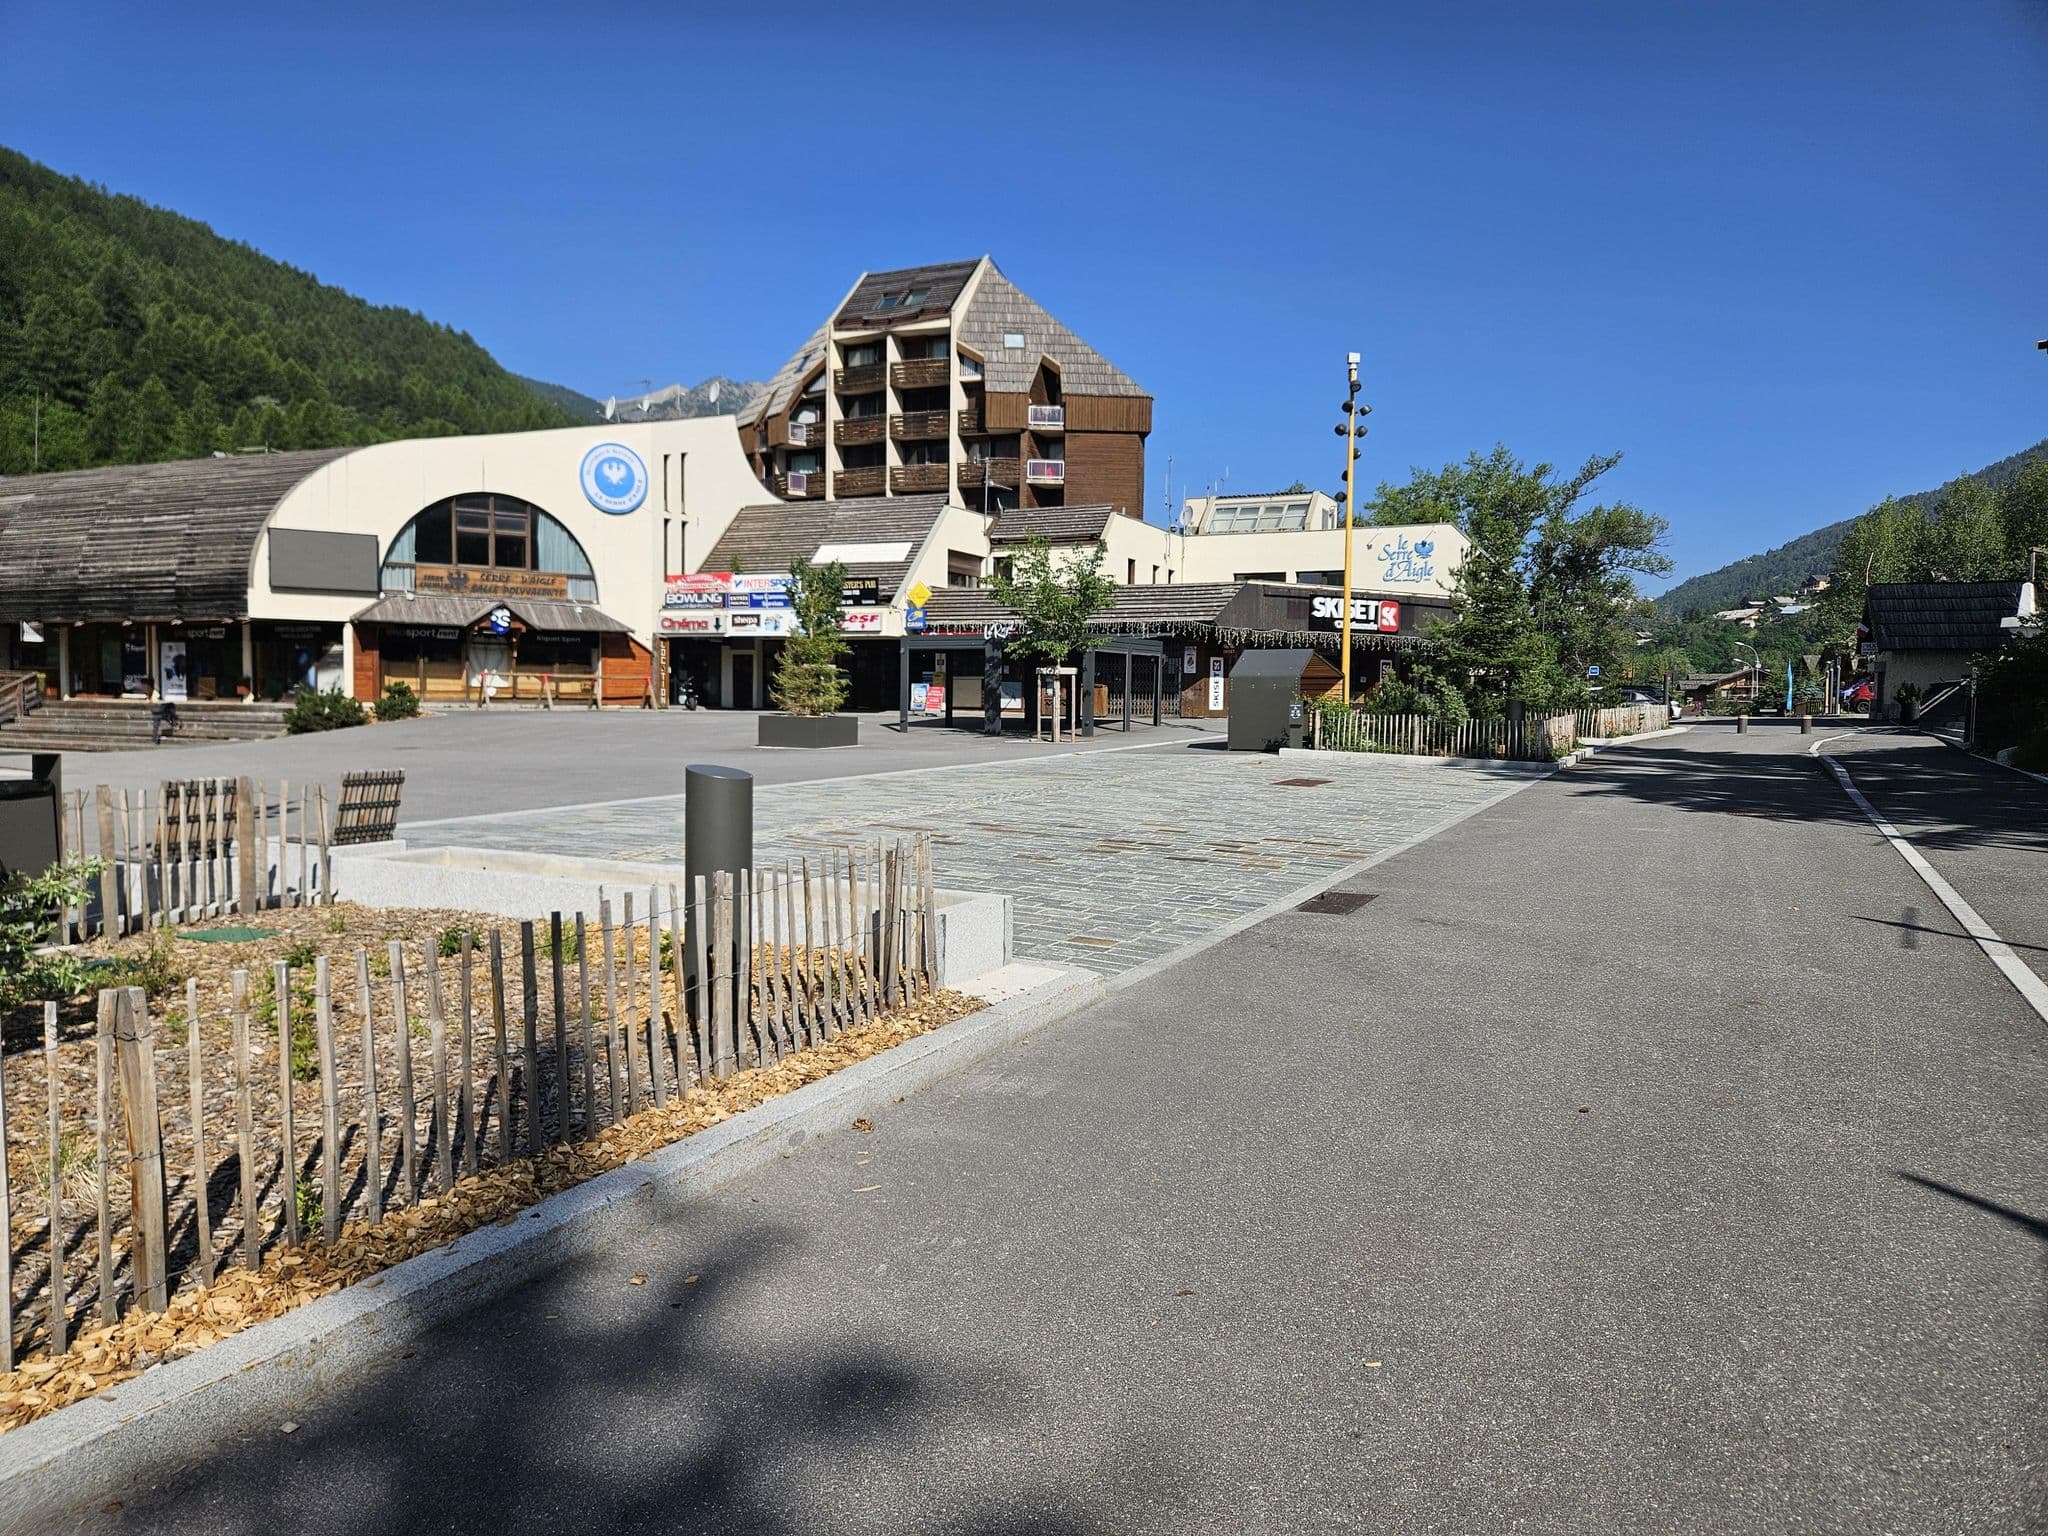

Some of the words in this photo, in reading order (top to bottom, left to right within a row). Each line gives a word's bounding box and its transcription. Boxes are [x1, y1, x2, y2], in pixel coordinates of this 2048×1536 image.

[1378, 543, 1413, 561] Serre
[744, 578, 799, 589] INTERSPOR
[666, 593, 723, 604] BOWLING
[661, 617, 709, 631] Cinéma
[734, 616, 758, 626] sherpa
